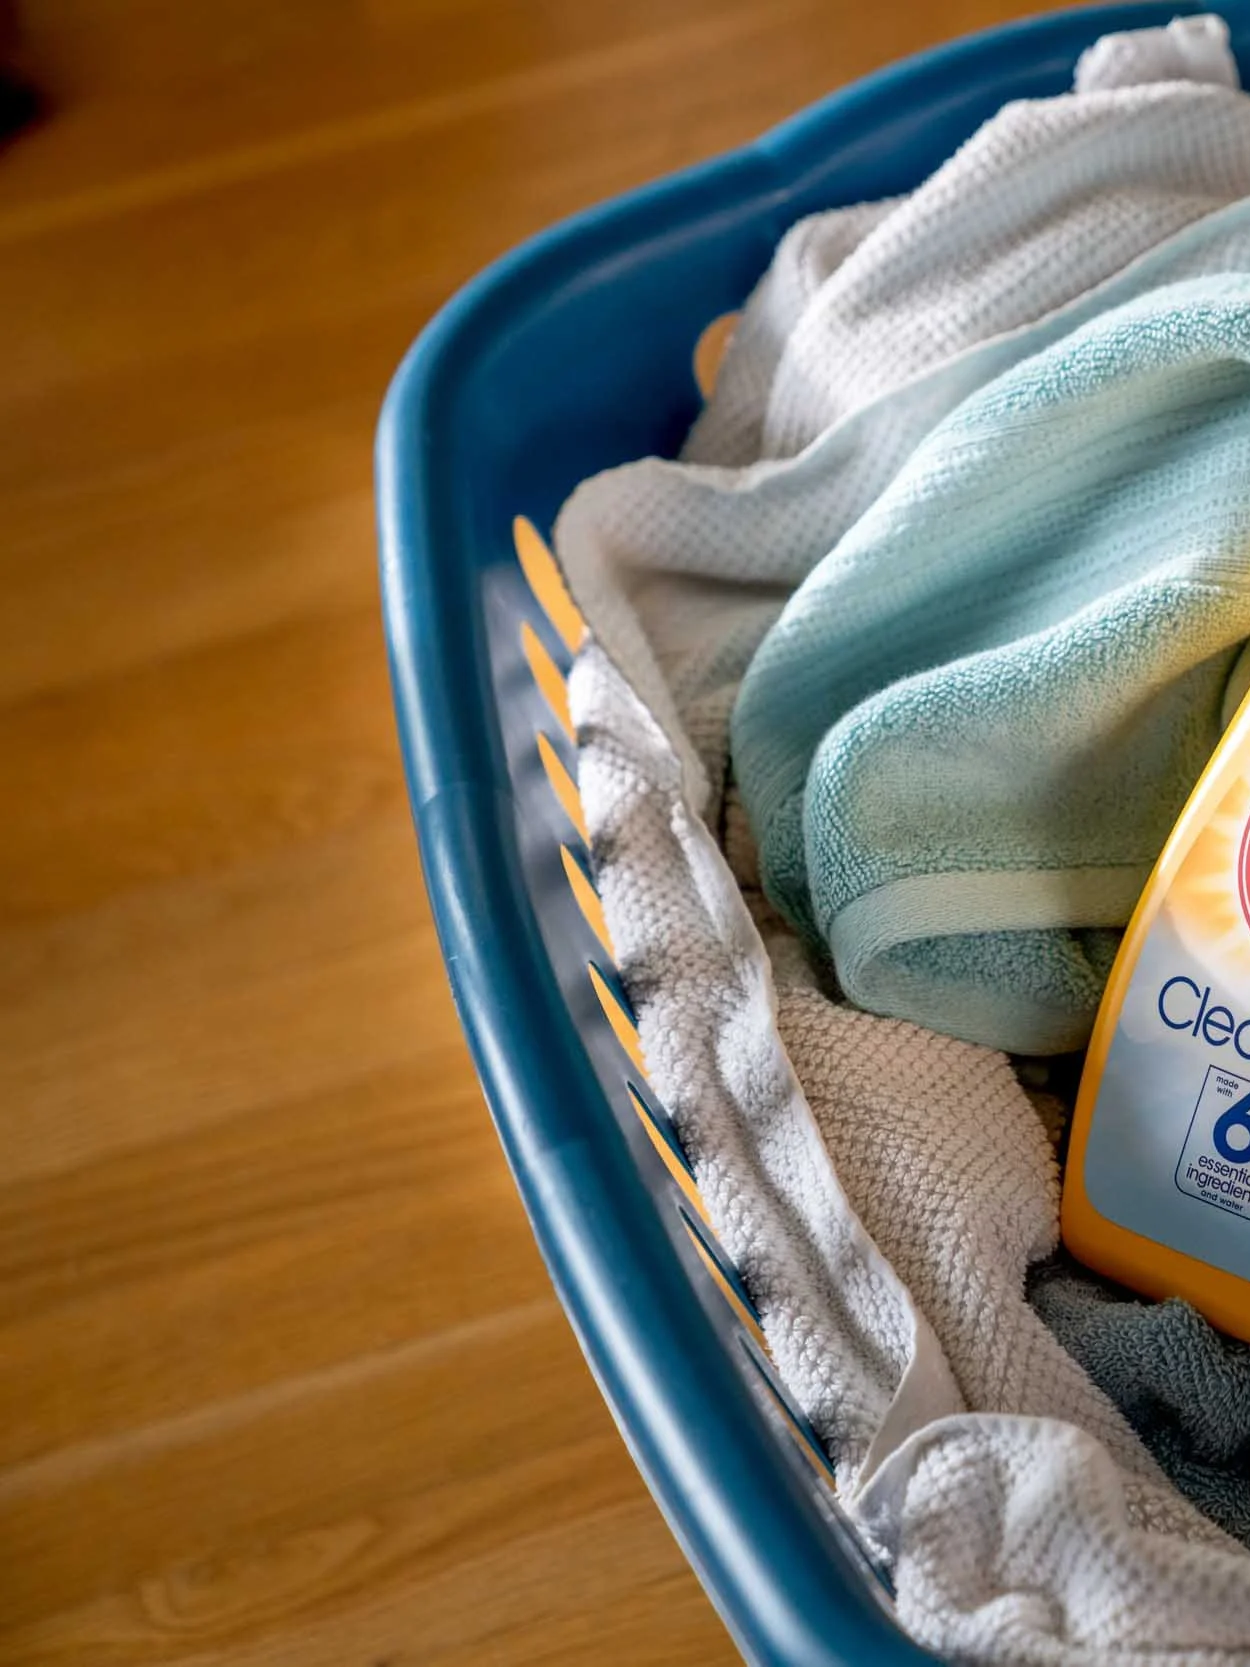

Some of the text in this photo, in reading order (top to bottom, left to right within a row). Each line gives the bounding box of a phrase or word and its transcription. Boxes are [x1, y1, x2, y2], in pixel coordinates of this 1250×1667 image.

[1216, 1074, 1240, 1090] made
[1216, 1086, 1233, 1098] with
[1200, 1189, 1244, 1212] and water
